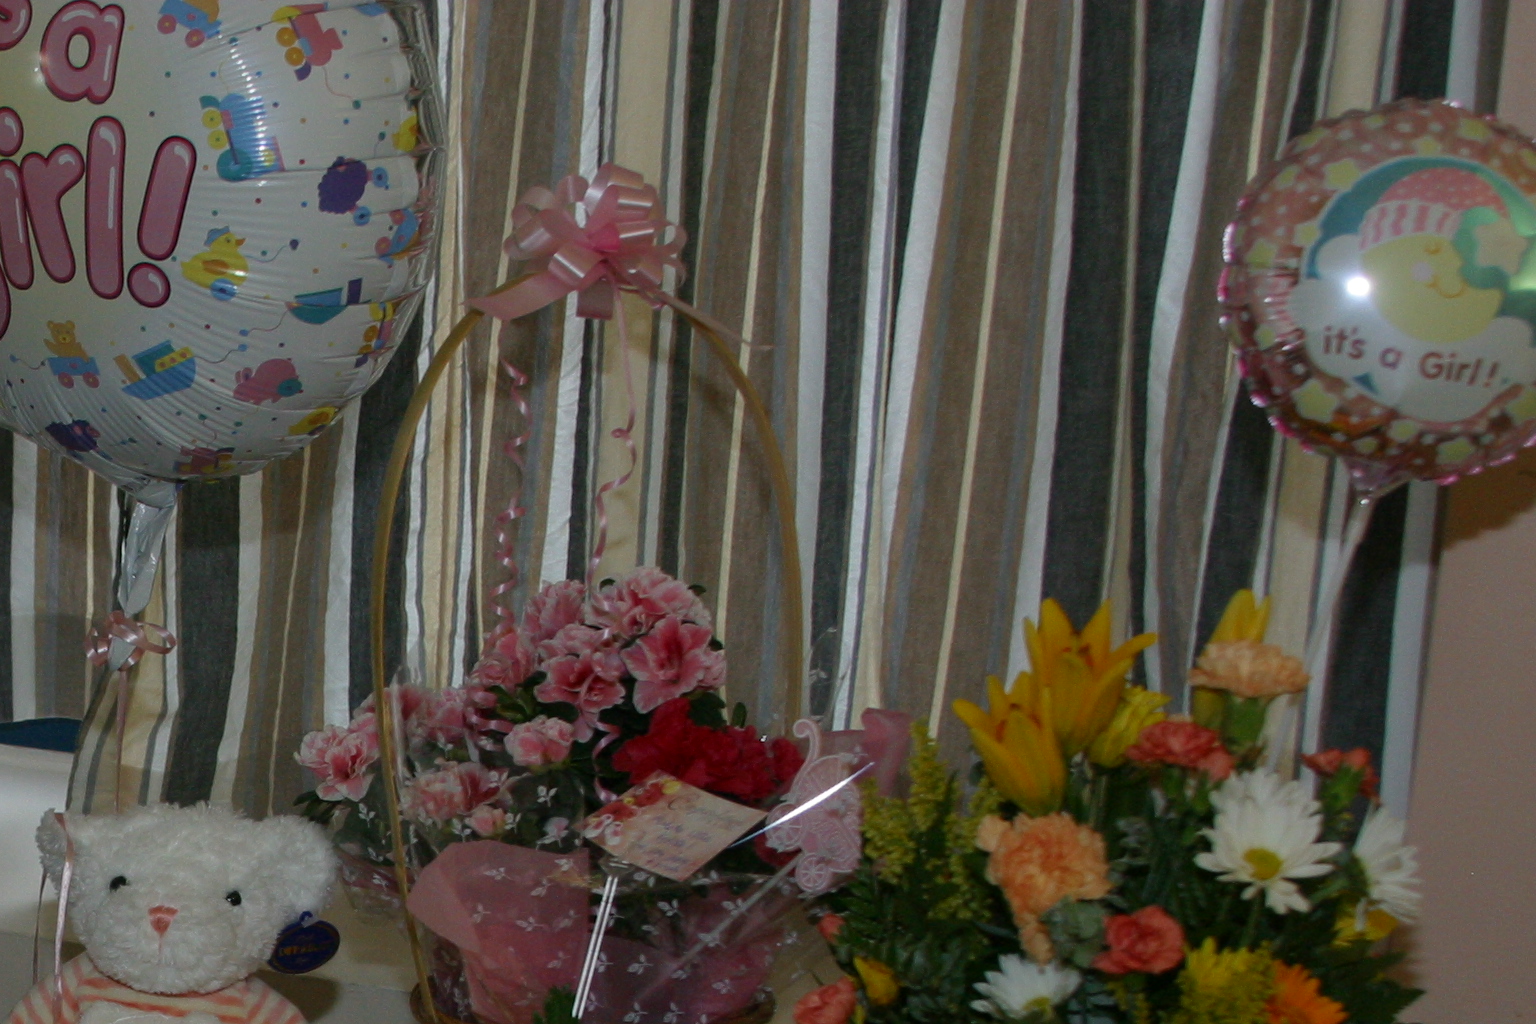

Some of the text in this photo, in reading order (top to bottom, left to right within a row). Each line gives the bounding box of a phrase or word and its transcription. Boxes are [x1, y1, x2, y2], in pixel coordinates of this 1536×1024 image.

[39, 0, 125, 104] a
[1322, 325, 1366, 360] it's
[1379, 347, 1404, 371] a
